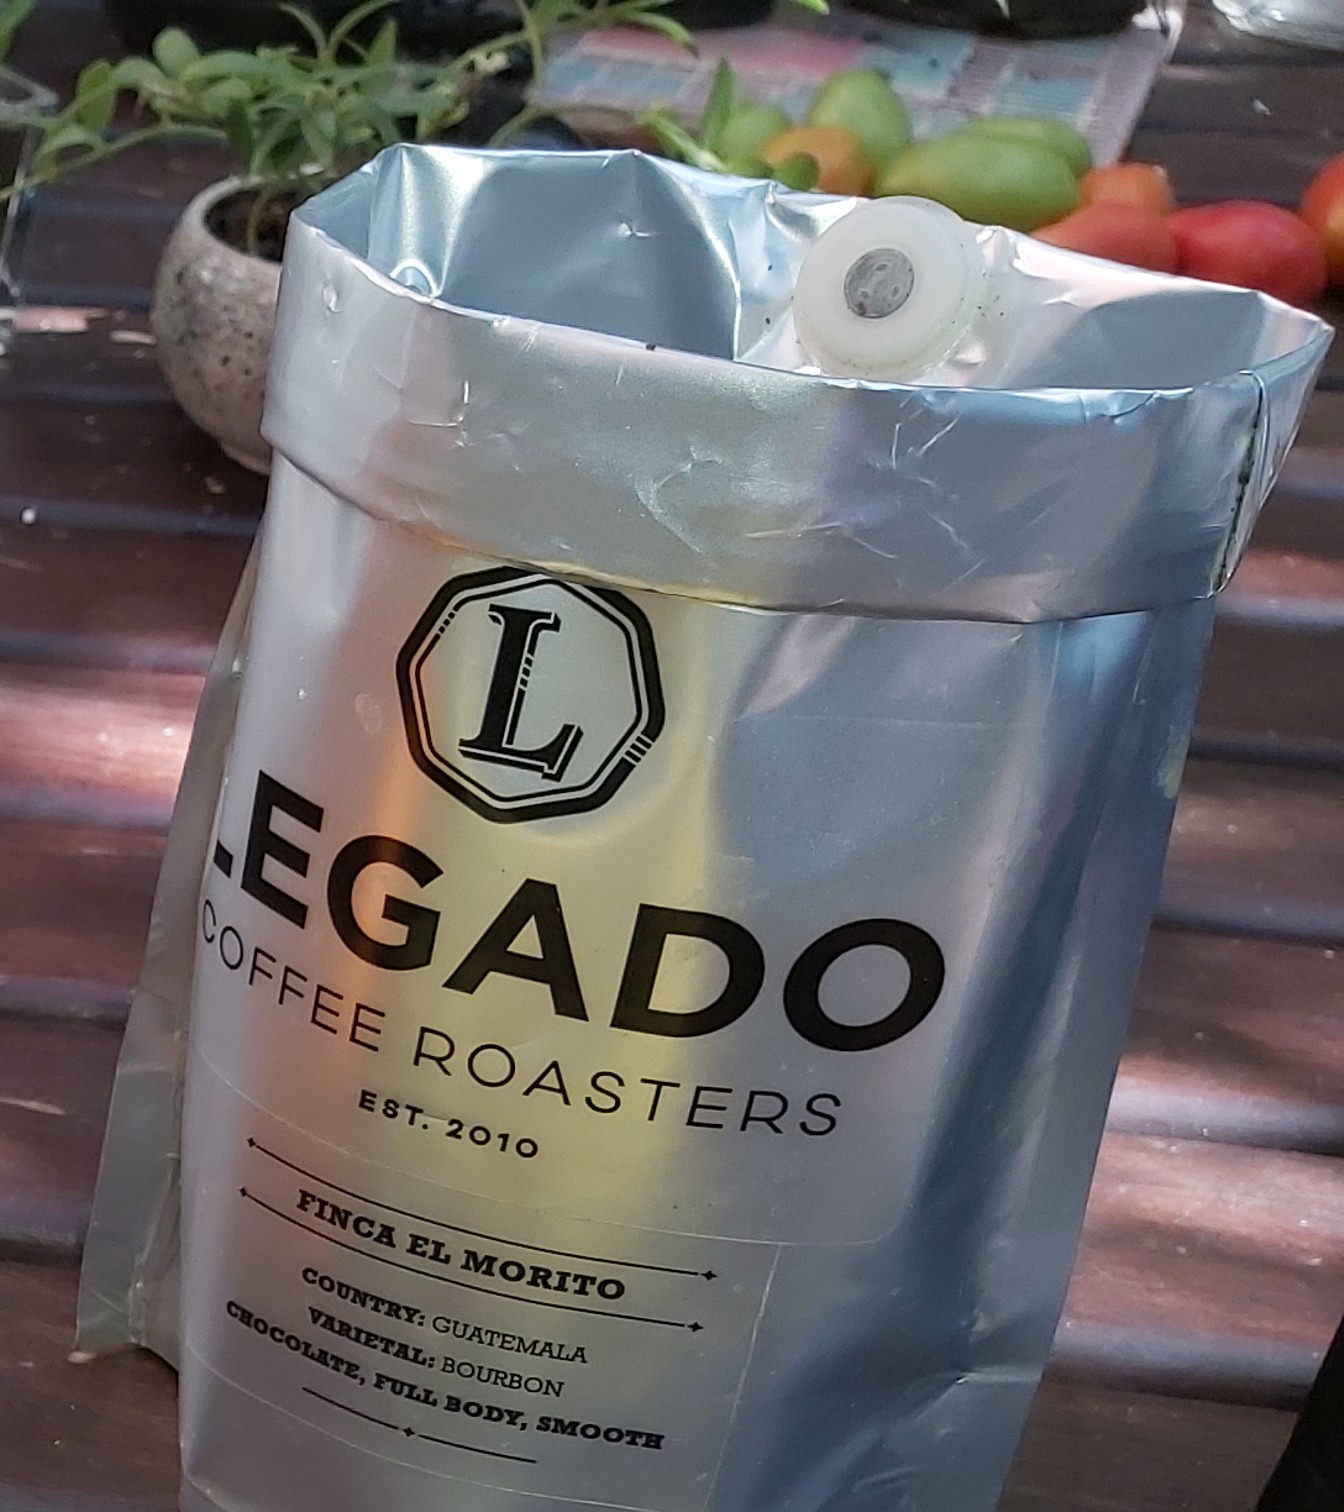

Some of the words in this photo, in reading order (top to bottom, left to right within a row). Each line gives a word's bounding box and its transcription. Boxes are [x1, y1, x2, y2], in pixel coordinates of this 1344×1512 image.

[201, 899, 387, 1052] COFFEE
[412, 1025, 843, 1137] ROASTERS
[357, 1088, 430, 1131] EST.
[444, 1118, 540, 1159] 2010
[295, 1188, 397, 1249] FINCA
[405, 1232, 452, 1266] EL
[460, 1248, 626, 1301] MORITO
[301, 1266, 426, 1327] COUNTRY:
[431, 1315, 588, 1364] GUATEMALA
[307, 1305, 435, 1369] VARIETAL:
[440, 1355, 565, 1398] BOURBON
[225, 1300, 366, 1386] CHOCOLATE,
[372, 1372, 438, 1407] FULL
[442, 1394, 529, 1432] BODY,
[535, 1416, 666, 1451] SMOOTH
